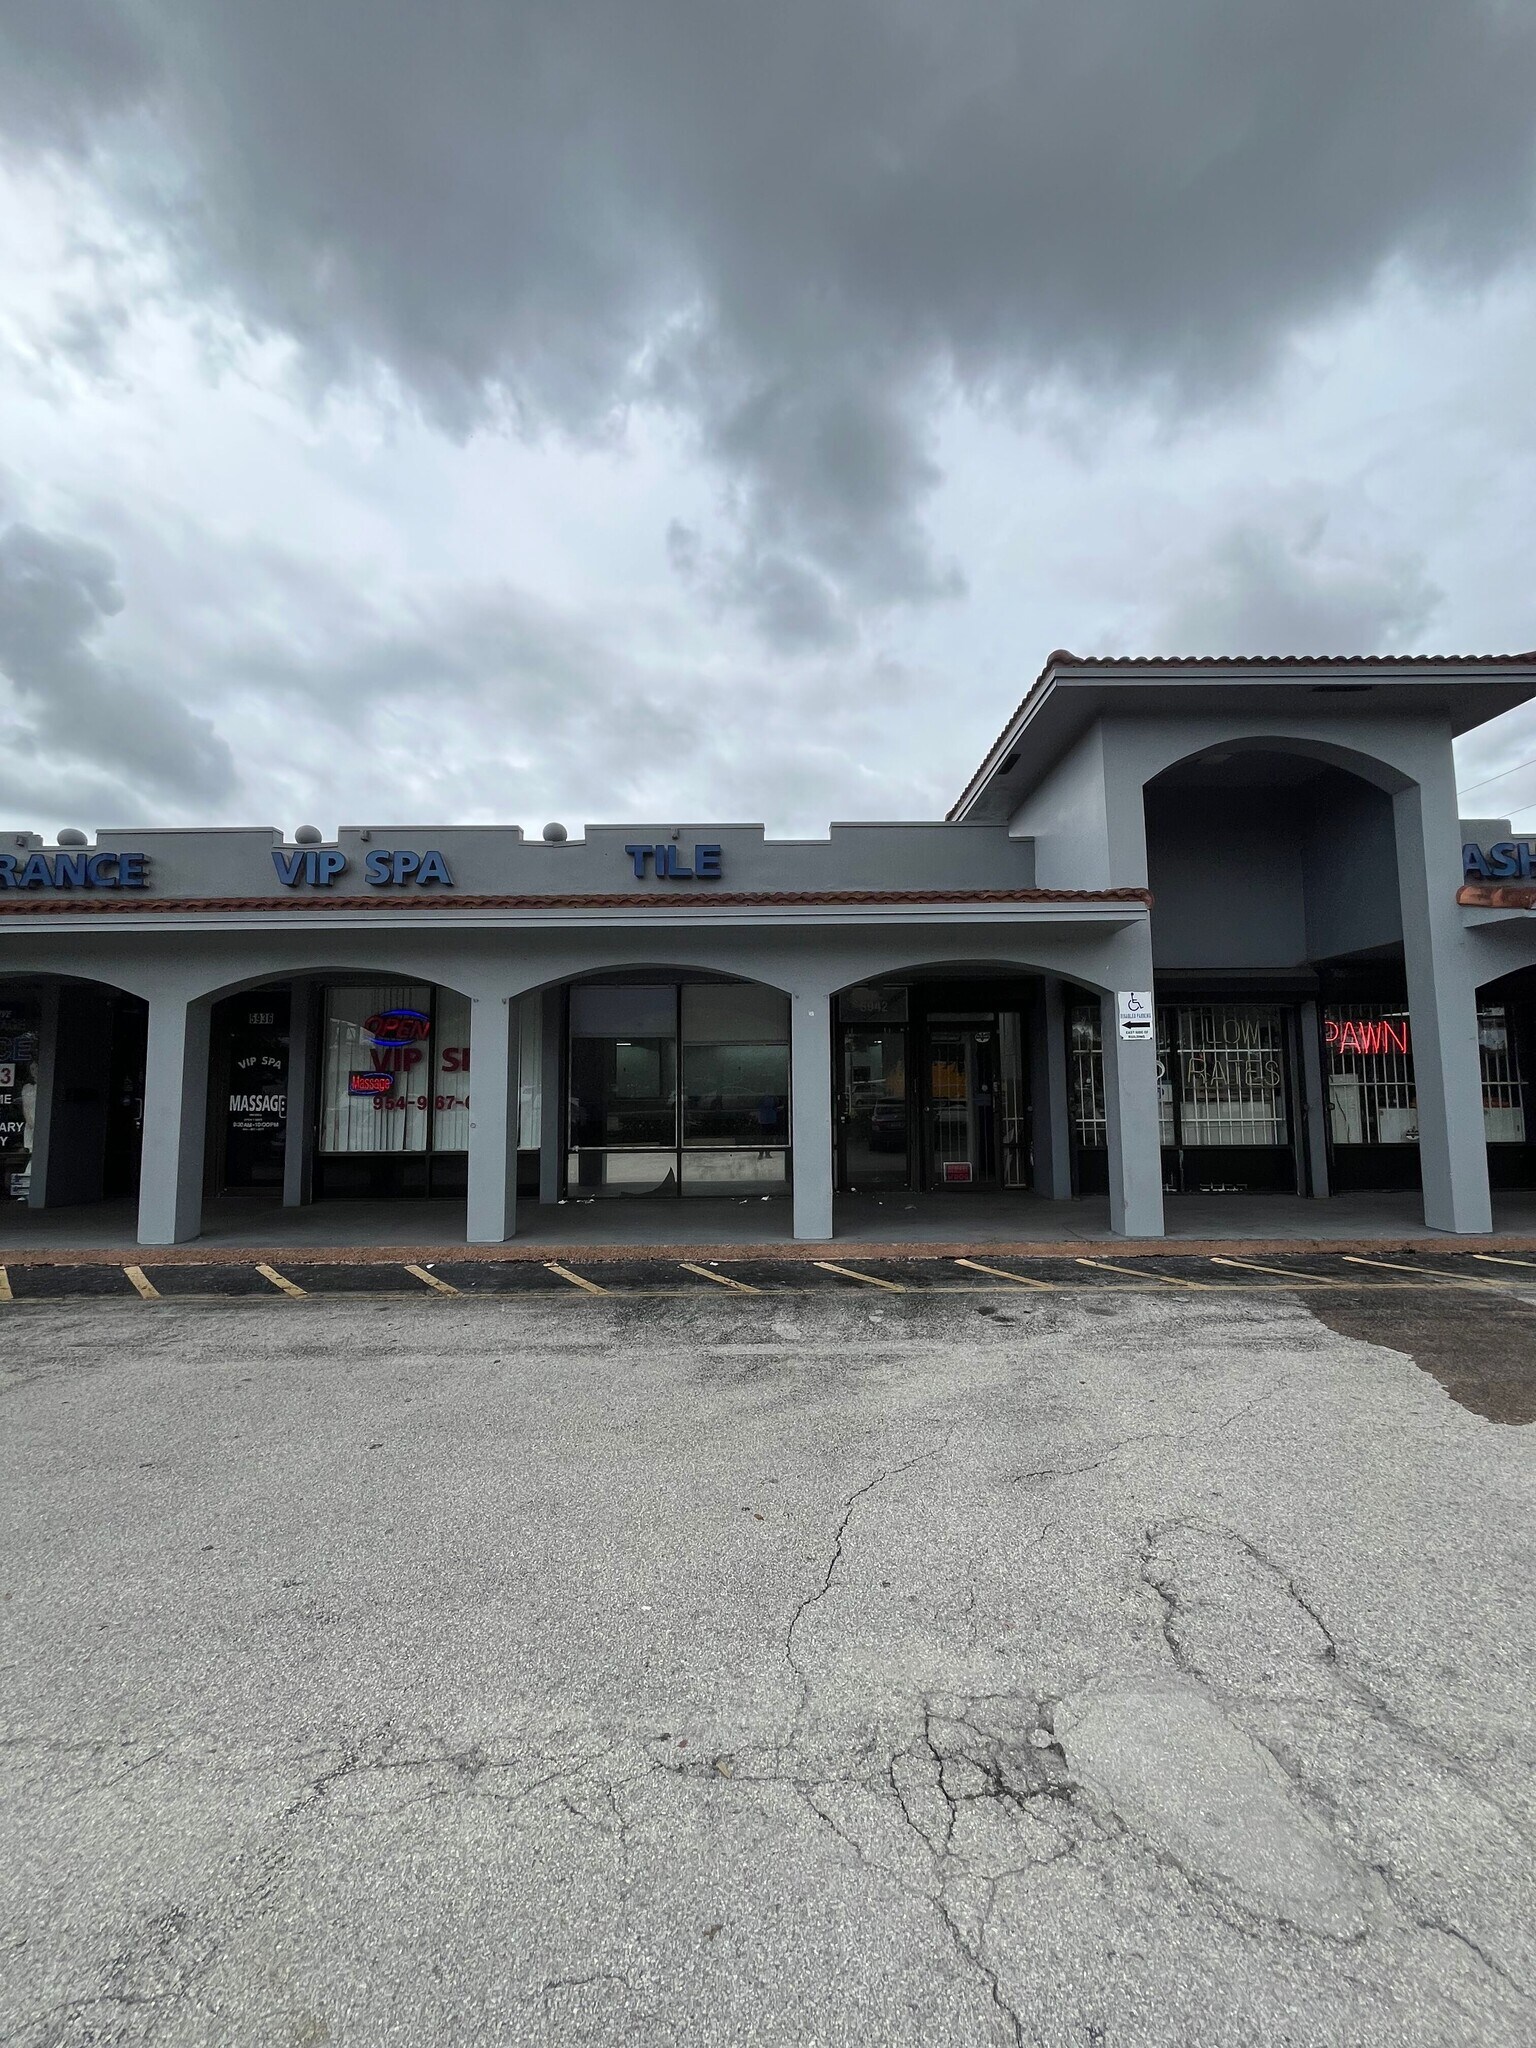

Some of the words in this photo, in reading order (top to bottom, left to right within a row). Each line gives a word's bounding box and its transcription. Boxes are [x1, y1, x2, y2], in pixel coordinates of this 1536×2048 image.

[272, 851, 347, 886] VIP
[365, 850, 453, 886] SPA
[625, 844, 722, 880] TILE
[365, 1015, 431, 1041] OPEN
[1205, 1018, 1259, 1044] LOW
[1325, 1020, 1407, 1055] PAWN
[238, 1057, 257, 1070] VIP
[261, 1056, 282, 1070] SPA
[370, 1048, 422, 1072] VIP
[1187, 1058, 1280, 1086] RATES
[1, 1068, 11, 1084] 3
[351, 1075, 390, 1091] Massage
